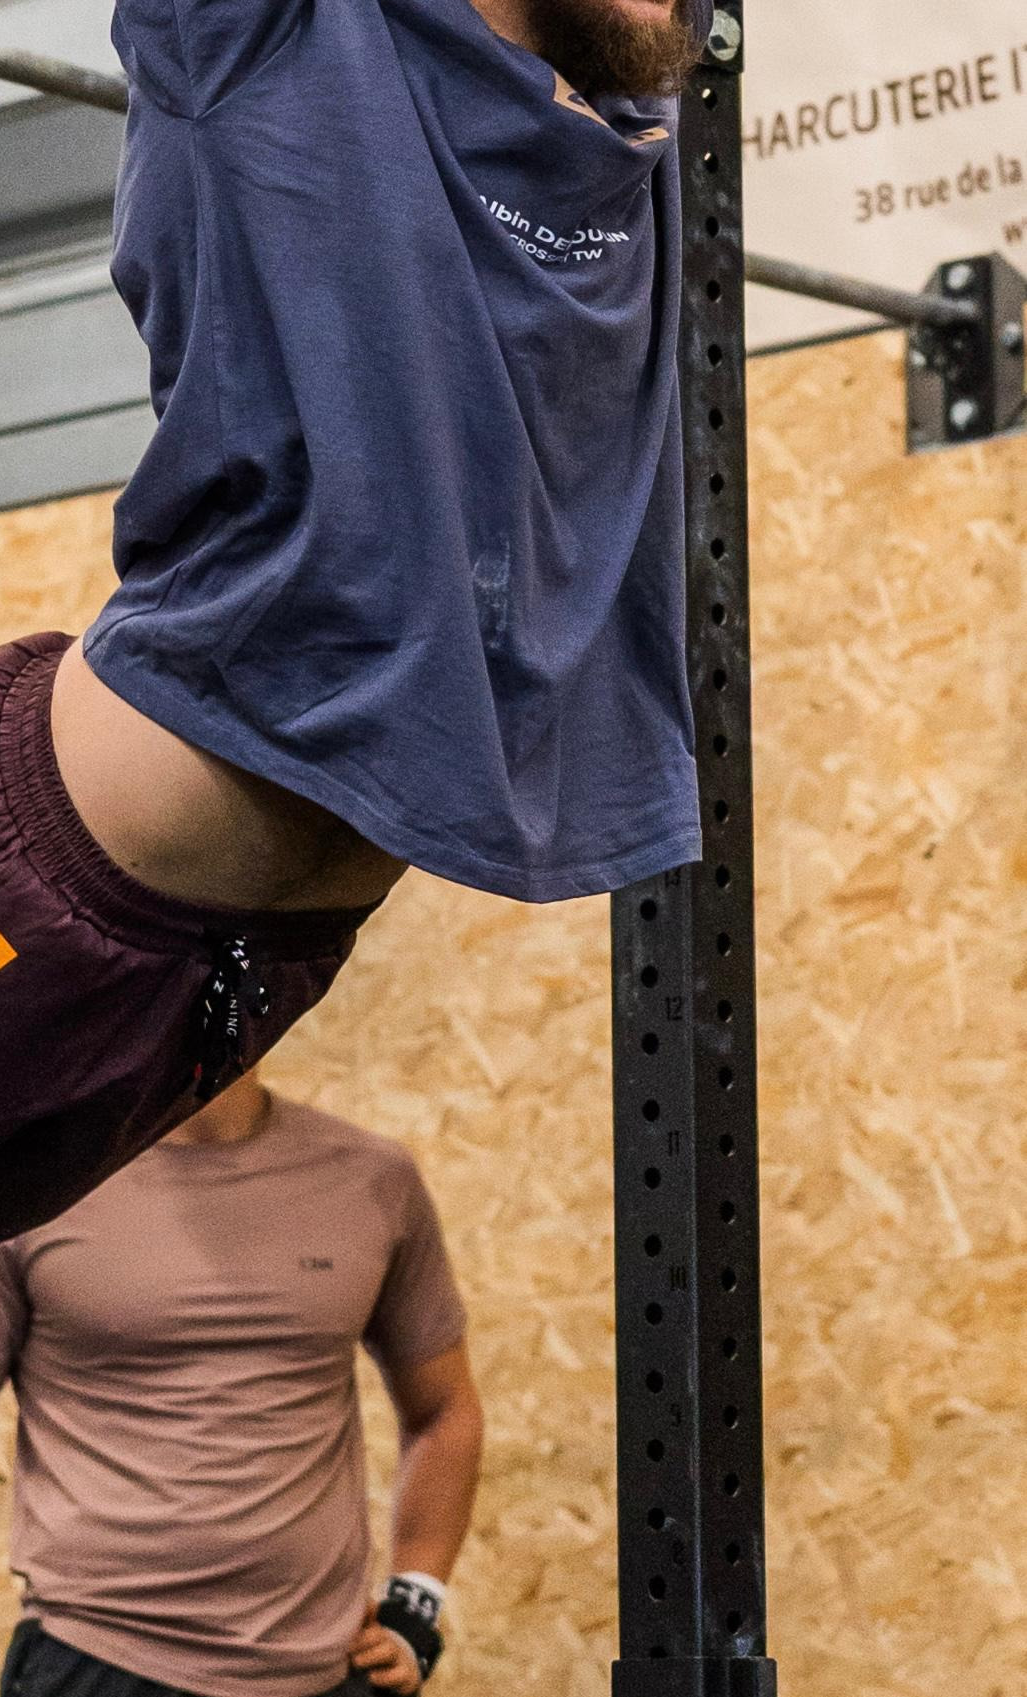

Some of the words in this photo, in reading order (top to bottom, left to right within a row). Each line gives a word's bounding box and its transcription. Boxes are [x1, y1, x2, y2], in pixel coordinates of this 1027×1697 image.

[854, 181, 895, 224] 38
[904, 177, 951, 210] rue
[956, 161, 991, 198] de
[996, 152, 1023, 187] la
